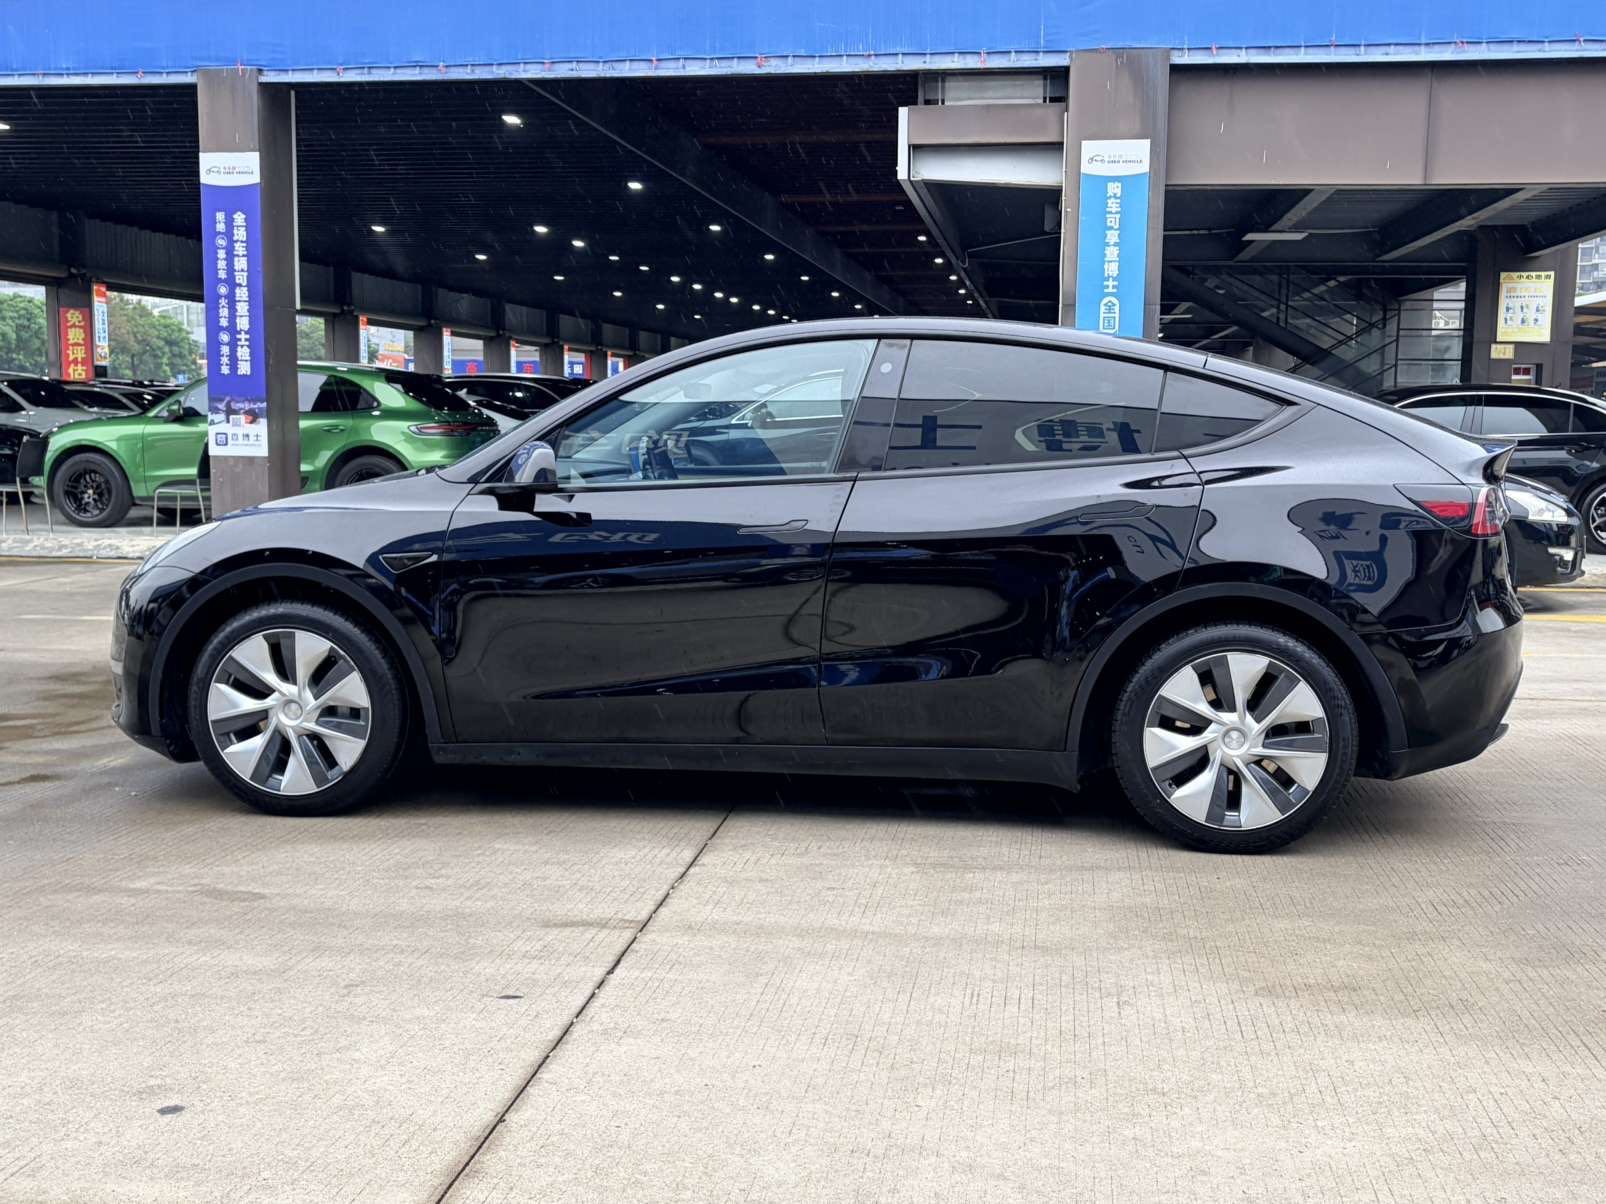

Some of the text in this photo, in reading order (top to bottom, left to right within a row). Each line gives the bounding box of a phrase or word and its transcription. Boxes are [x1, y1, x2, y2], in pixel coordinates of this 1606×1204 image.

[232, 211, 251, 376] 全场车辆可经查博士检测
[1103, 181, 1121, 330] 购车可享查博士 全国
[66, 309, 86, 381] 免费评估
